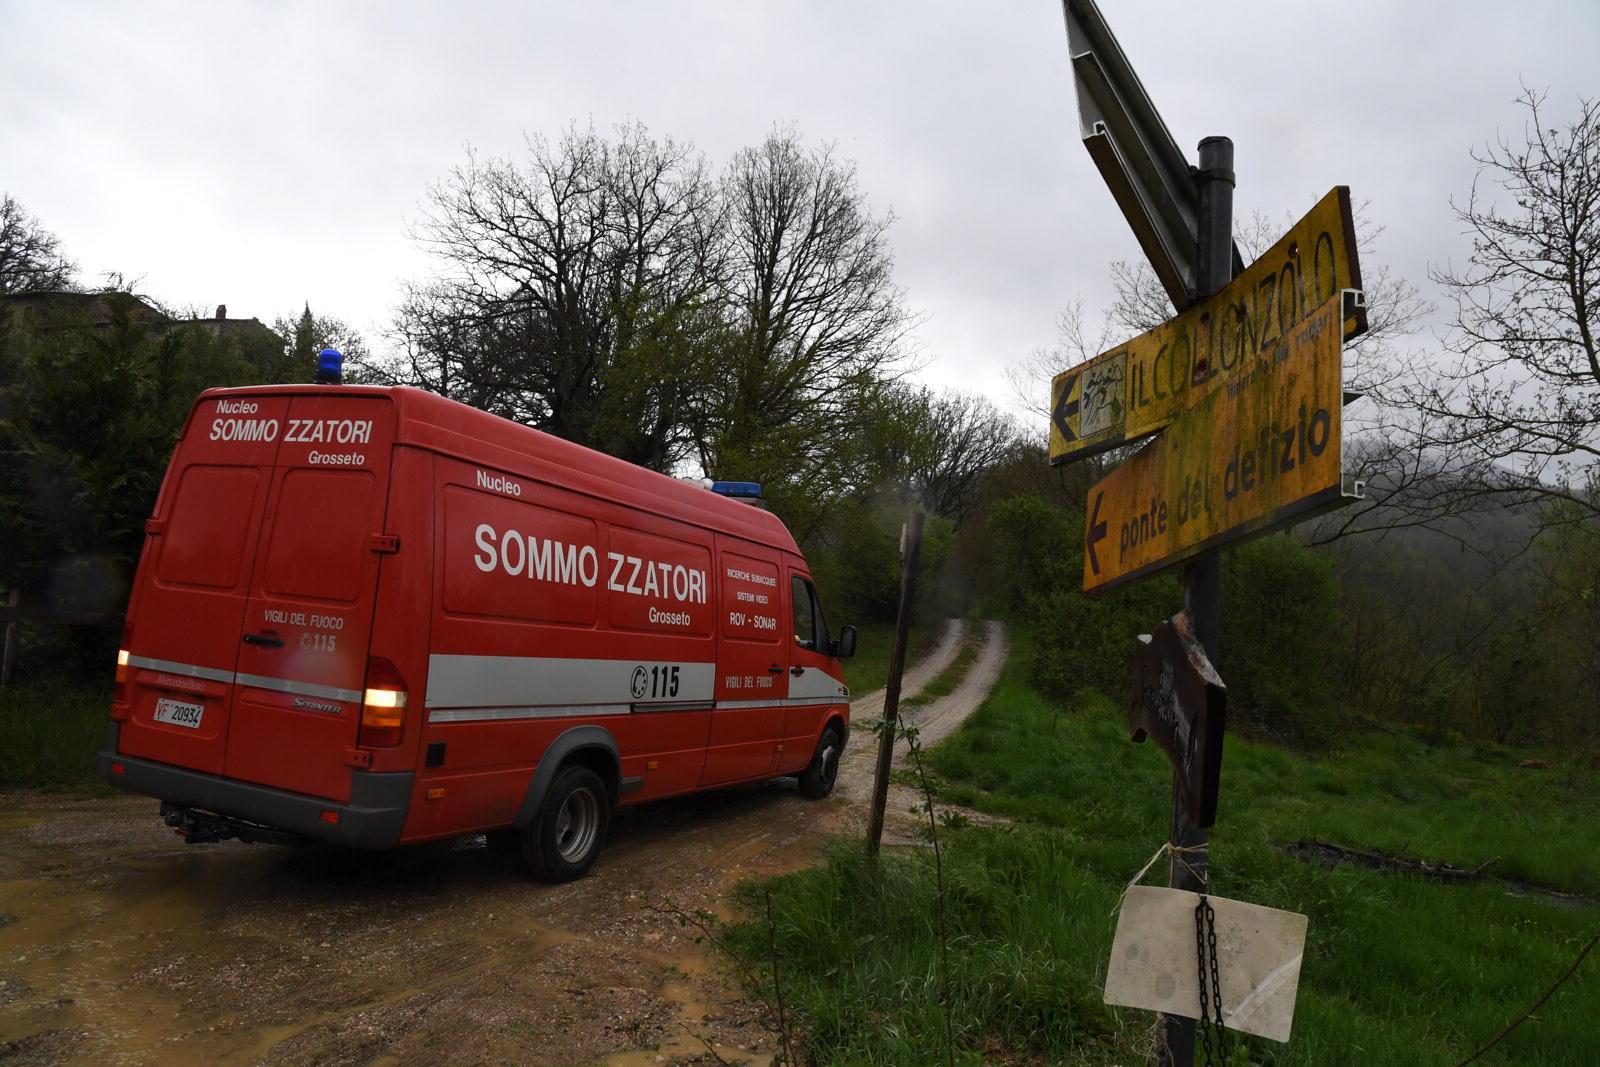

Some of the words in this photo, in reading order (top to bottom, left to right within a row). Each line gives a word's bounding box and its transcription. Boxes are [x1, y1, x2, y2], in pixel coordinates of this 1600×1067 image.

[216, 400, 258, 414] Nucleo
[308, 450, 365, 465] Grosseto
[476, 469, 521, 496] Nucleo
[1119, 496, 1169, 564] ponte
[726, 568, 750, 582] RICERCHE
[736, 591, 755, 603] SISTEMI
[755, 594, 769, 605] VIDEO
[264, 609, 288, 624] VIGILI
[290, 612, 307, 626] DEL
[310, 614, 344, 631] FUOCO
[649, 606, 691, 627] Grosseto
[729, 612, 746, 627] ROV
[753, 615, 777, 631] SONAR
[313, 633, 337, 652] 115
[651, 665, 680, 699] 115
[725, 675, 742, 689] VIGILI
[744, 676, 753, 689] DEL
[756, 676, 773, 689] FUOCO
[171, 703, 202, 726] 20934
